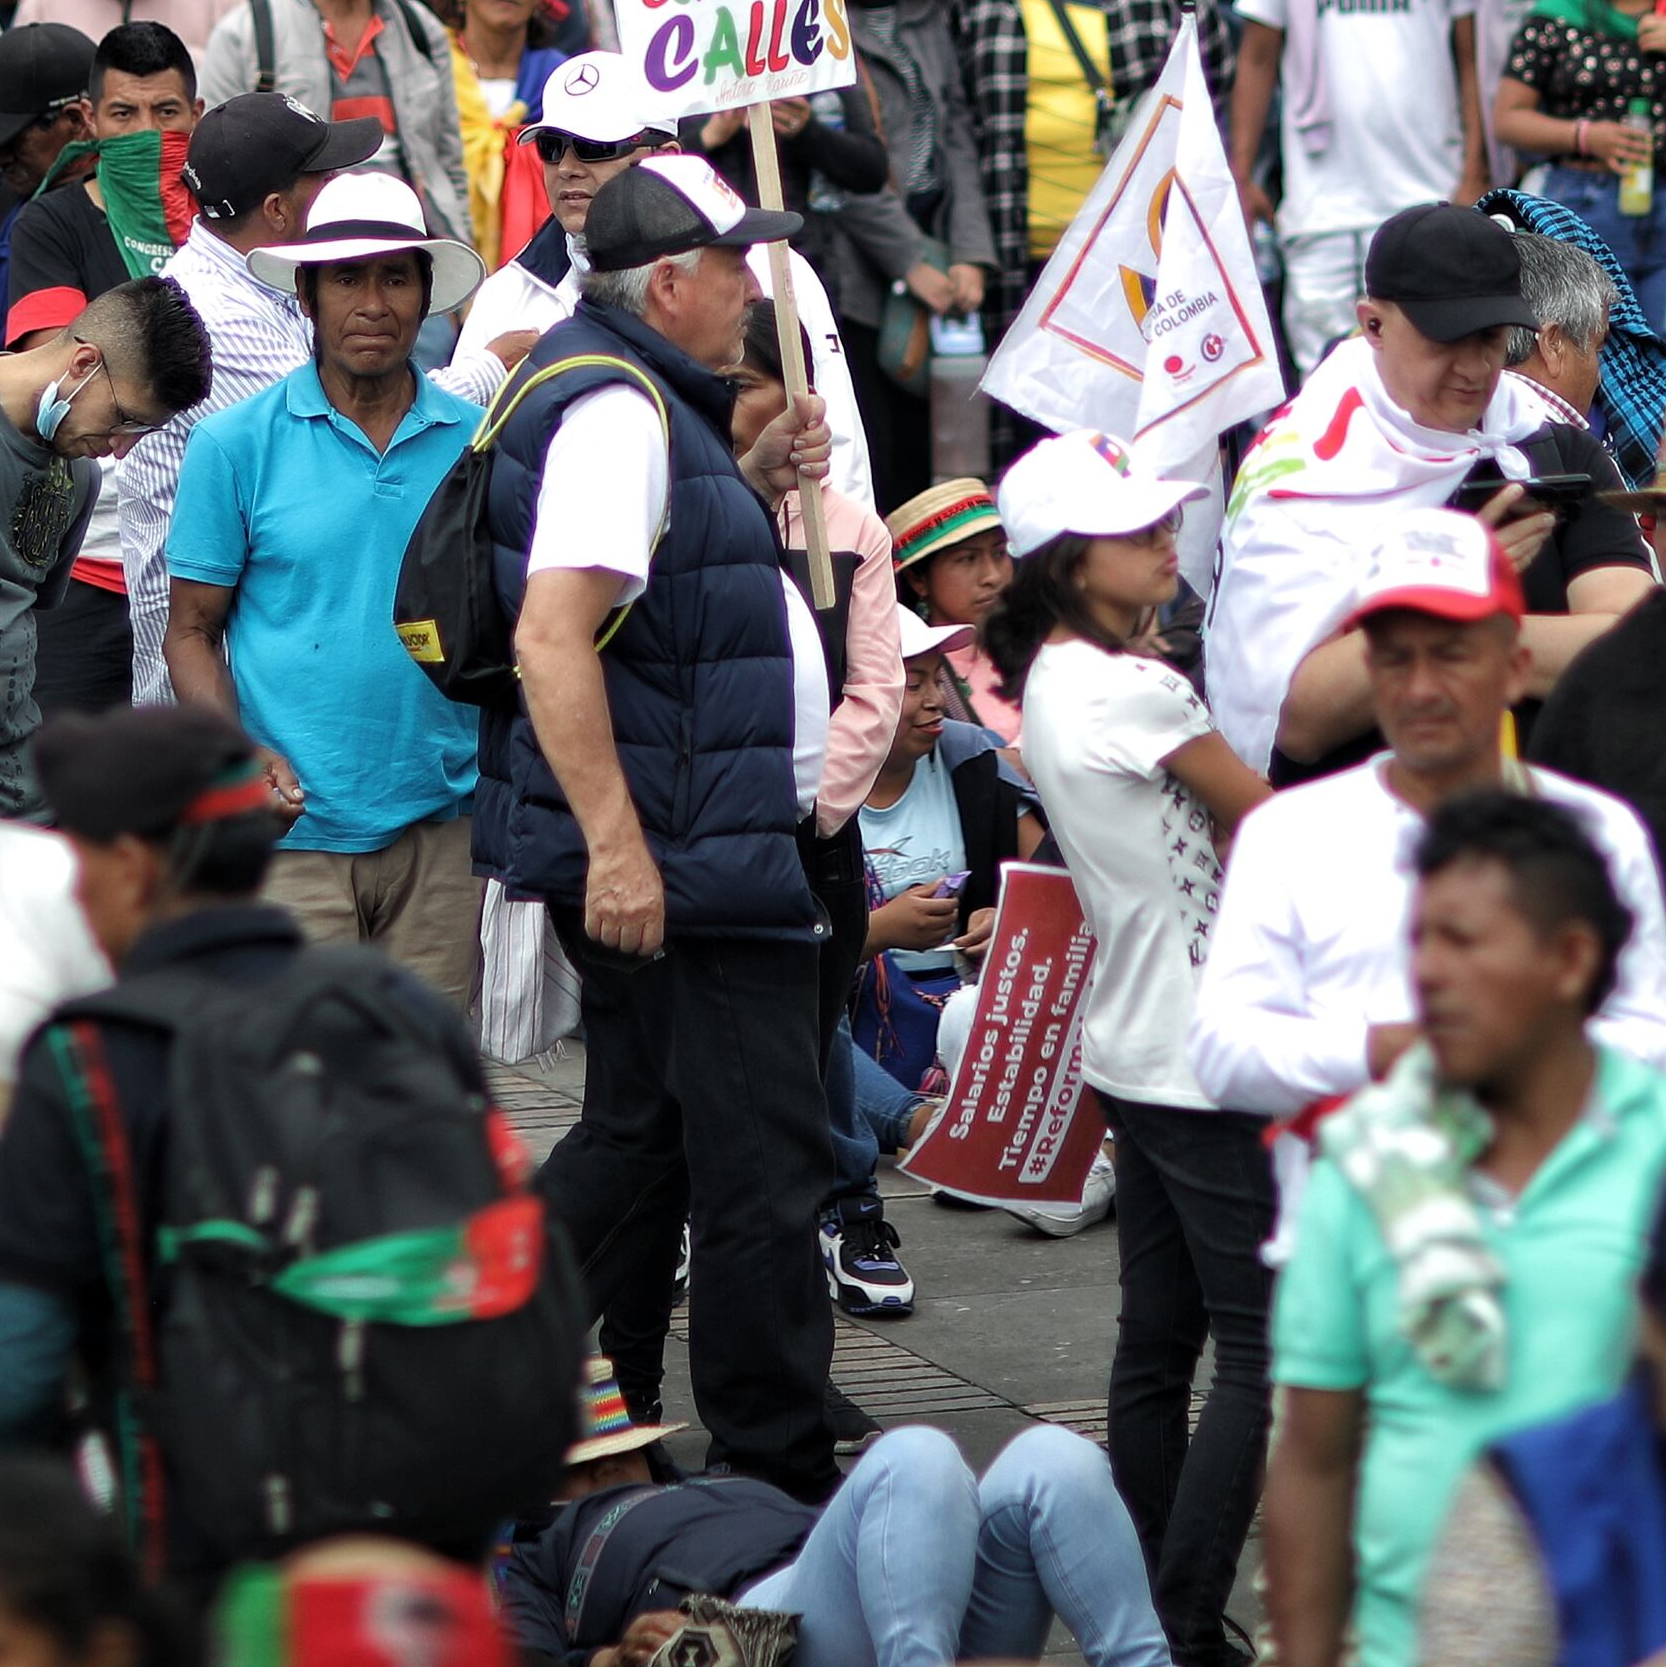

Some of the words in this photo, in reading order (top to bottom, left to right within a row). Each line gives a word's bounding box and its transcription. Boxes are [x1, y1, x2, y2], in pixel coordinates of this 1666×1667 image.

[1154, 291, 1218, 337] COLOMBIA
[949, 1029, 998, 1141] Salarios
[988, 927, 1030, 1027] justos.
[986, 958, 1053, 1124] Estabilidad.
[998, 1065, 1048, 1171] Tiempo
[1040, 1023, 1062, 1060] en
